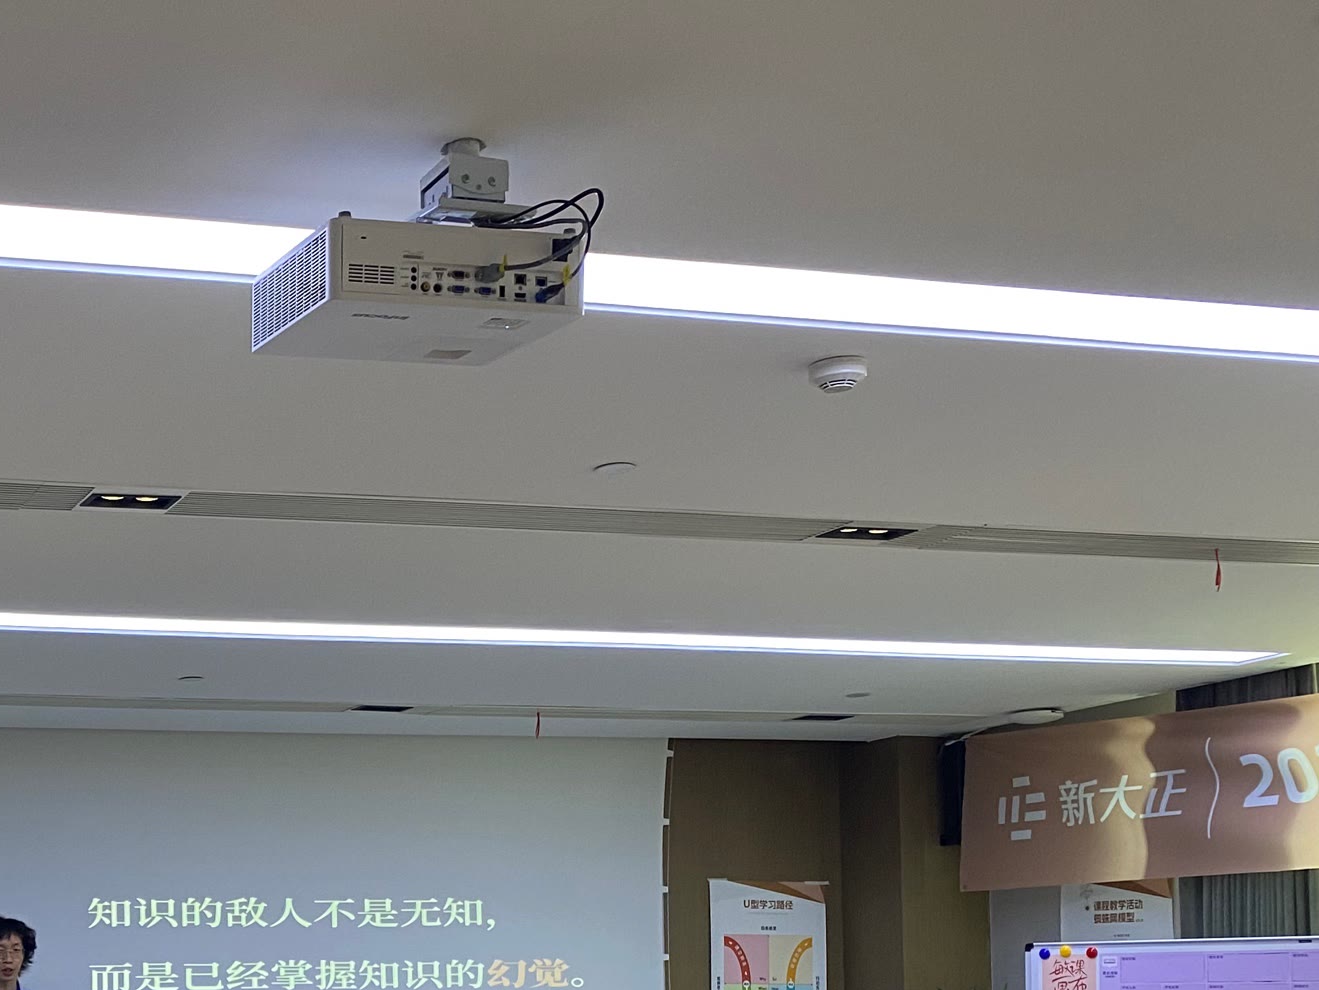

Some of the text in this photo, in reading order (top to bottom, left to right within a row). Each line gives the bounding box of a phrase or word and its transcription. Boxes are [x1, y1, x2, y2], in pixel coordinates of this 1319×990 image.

[1059, 769, 1187, 828] 新大正
[1239, 746, 1319, 807] 20
